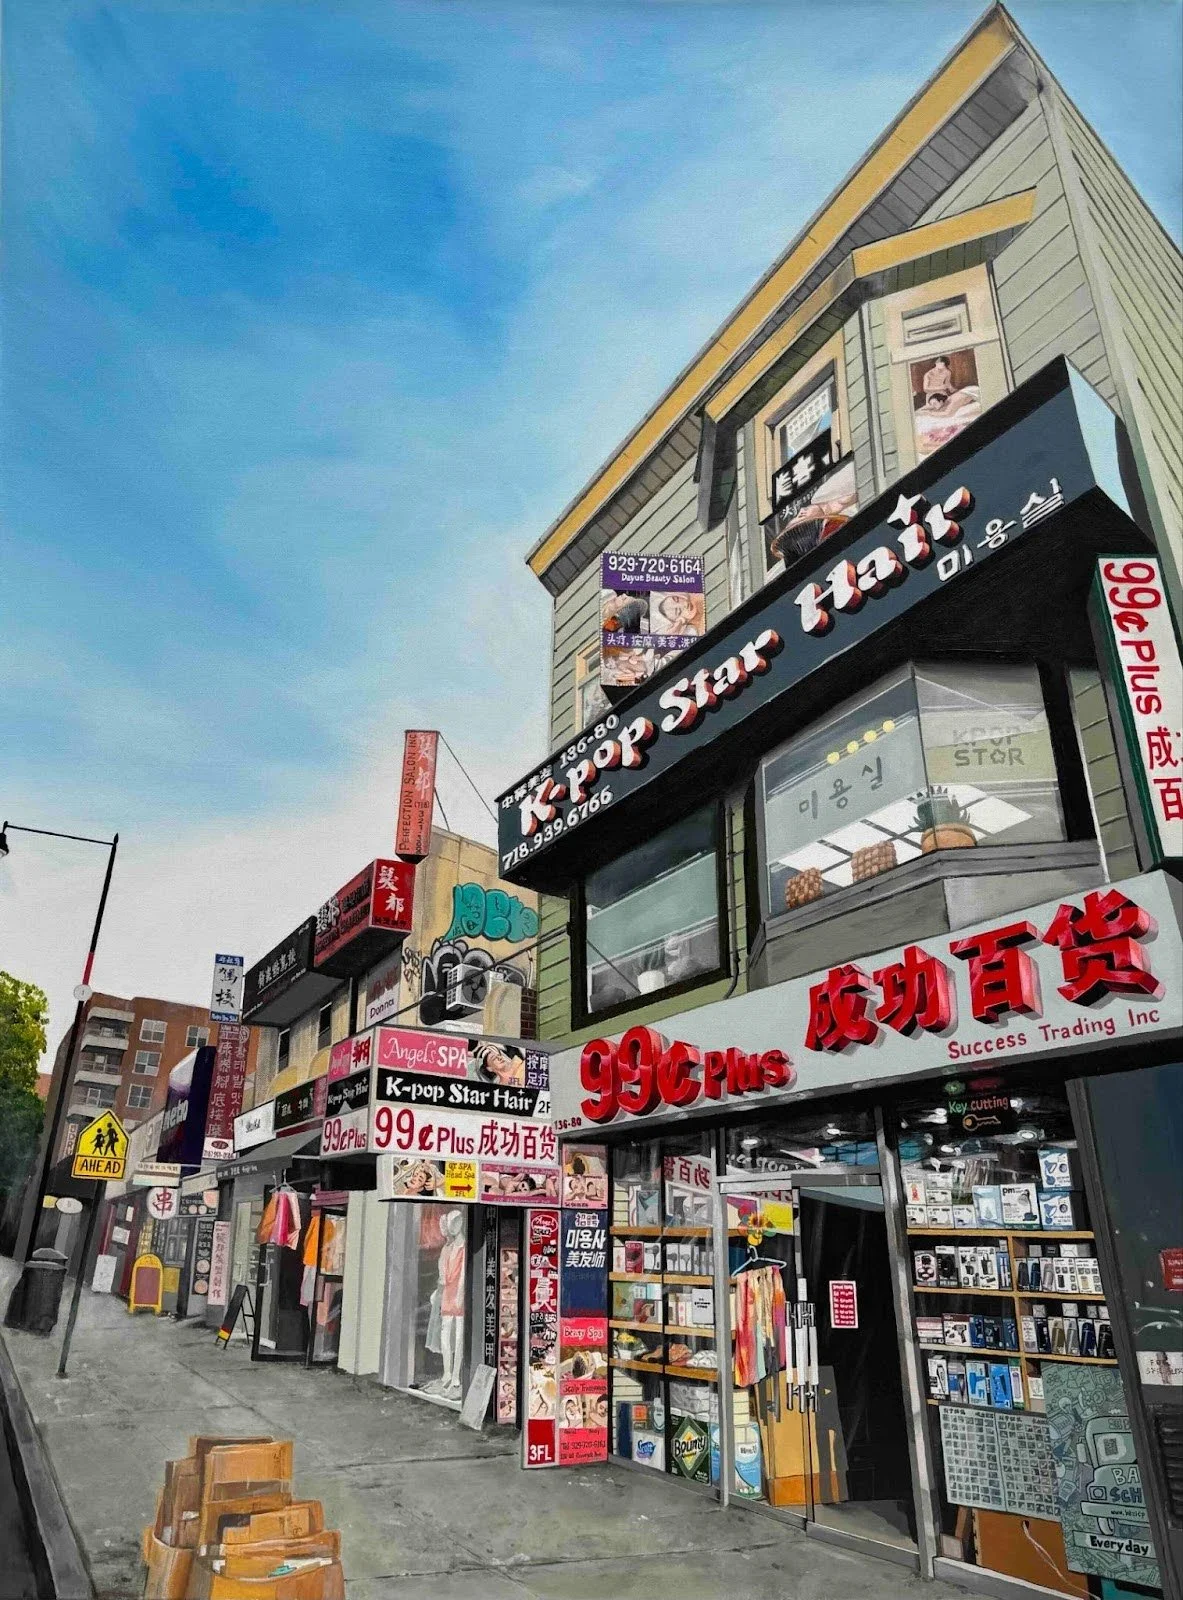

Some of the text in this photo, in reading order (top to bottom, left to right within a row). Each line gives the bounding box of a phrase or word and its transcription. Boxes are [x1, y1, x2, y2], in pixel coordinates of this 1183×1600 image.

[936, 477, 1066, 582] 미용실
[645, 574, 671, 585] Beauty
[672, 575, 695, 584] Salon
[658, 628, 780, 734] Star
[793, 485, 976, 634] Hair
[1120, 639, 1163, 716] Plus
[559, 714, 620, 769] 136-80
[398, 732, 418, 851] PERFECTION SALON INC
[799, 755, 883, 820] 미용실
[501, 784, 615, 872] 718.939.6766
[804, 887, 1168, 1053] 成功百货
[369, 998, 395, 1019] Donna
[947, 1006, 1161, 1060] Success Trading Inc
[437, 1045, 468, 1069] SPA
[526, 1072, 549, 1087] 足疗
[703, 1047, 795, 1100] Plus
[385, 1076, 446, 1103] K-pop
[448, 1083, 491, 1107] Star
[493, 1088, 533, 1112] Hair
[948, 1096, 1009, 1114] Key cutting
[553, 1117, 582, 1130] 136-80
[348, 1127, 366, 1150] Plus
[437, 1126, 475, 1155] Plus
[477, 1118, 557, 1161] 成功百货
[79, 1158, 122, 1175] AHEAD
[446, 1170, 476, 1180] Head Spa
[459, 1162, 473, 1171] SPA
[152, 1187, 173, 1217] 串
[565, 1229, 607, 1249] 미용사
[565, 1250, 607, 1268] 美发师
[587, 1325, 604, 1339] Spa
[529, 1444, 552, 1461] 3FL
[1089, 1534, 1150, 1556] Everyday
